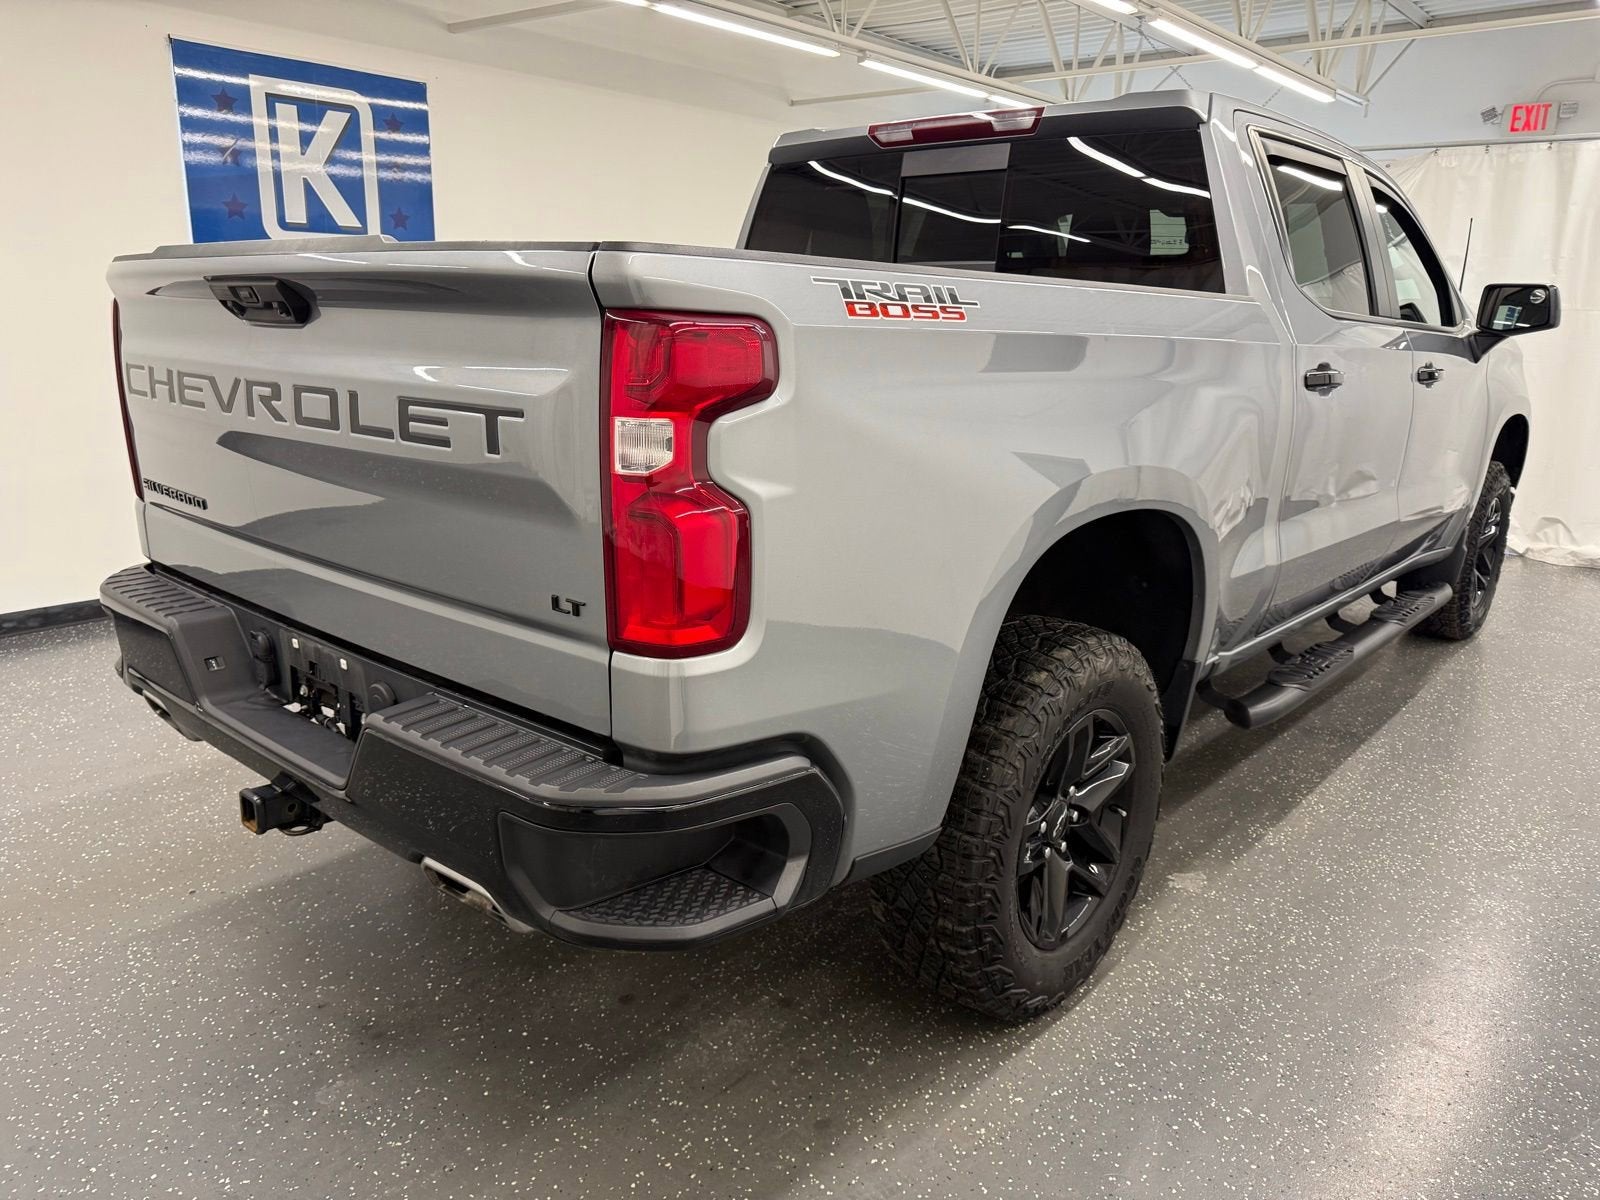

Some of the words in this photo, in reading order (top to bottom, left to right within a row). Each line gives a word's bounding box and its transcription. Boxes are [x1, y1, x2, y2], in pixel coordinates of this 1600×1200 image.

[1509, 103, 1552, 133] EXIT
[275, 102, 362, 228] K
[810, 276, 981, 308] TRAIL
[844, 299, 967, 322] BOSS
[125, 361, 525, 457] CHEVROLET
[143, 477, 208, 510] SILVERADO
[551, 594, 586, 617] LT
